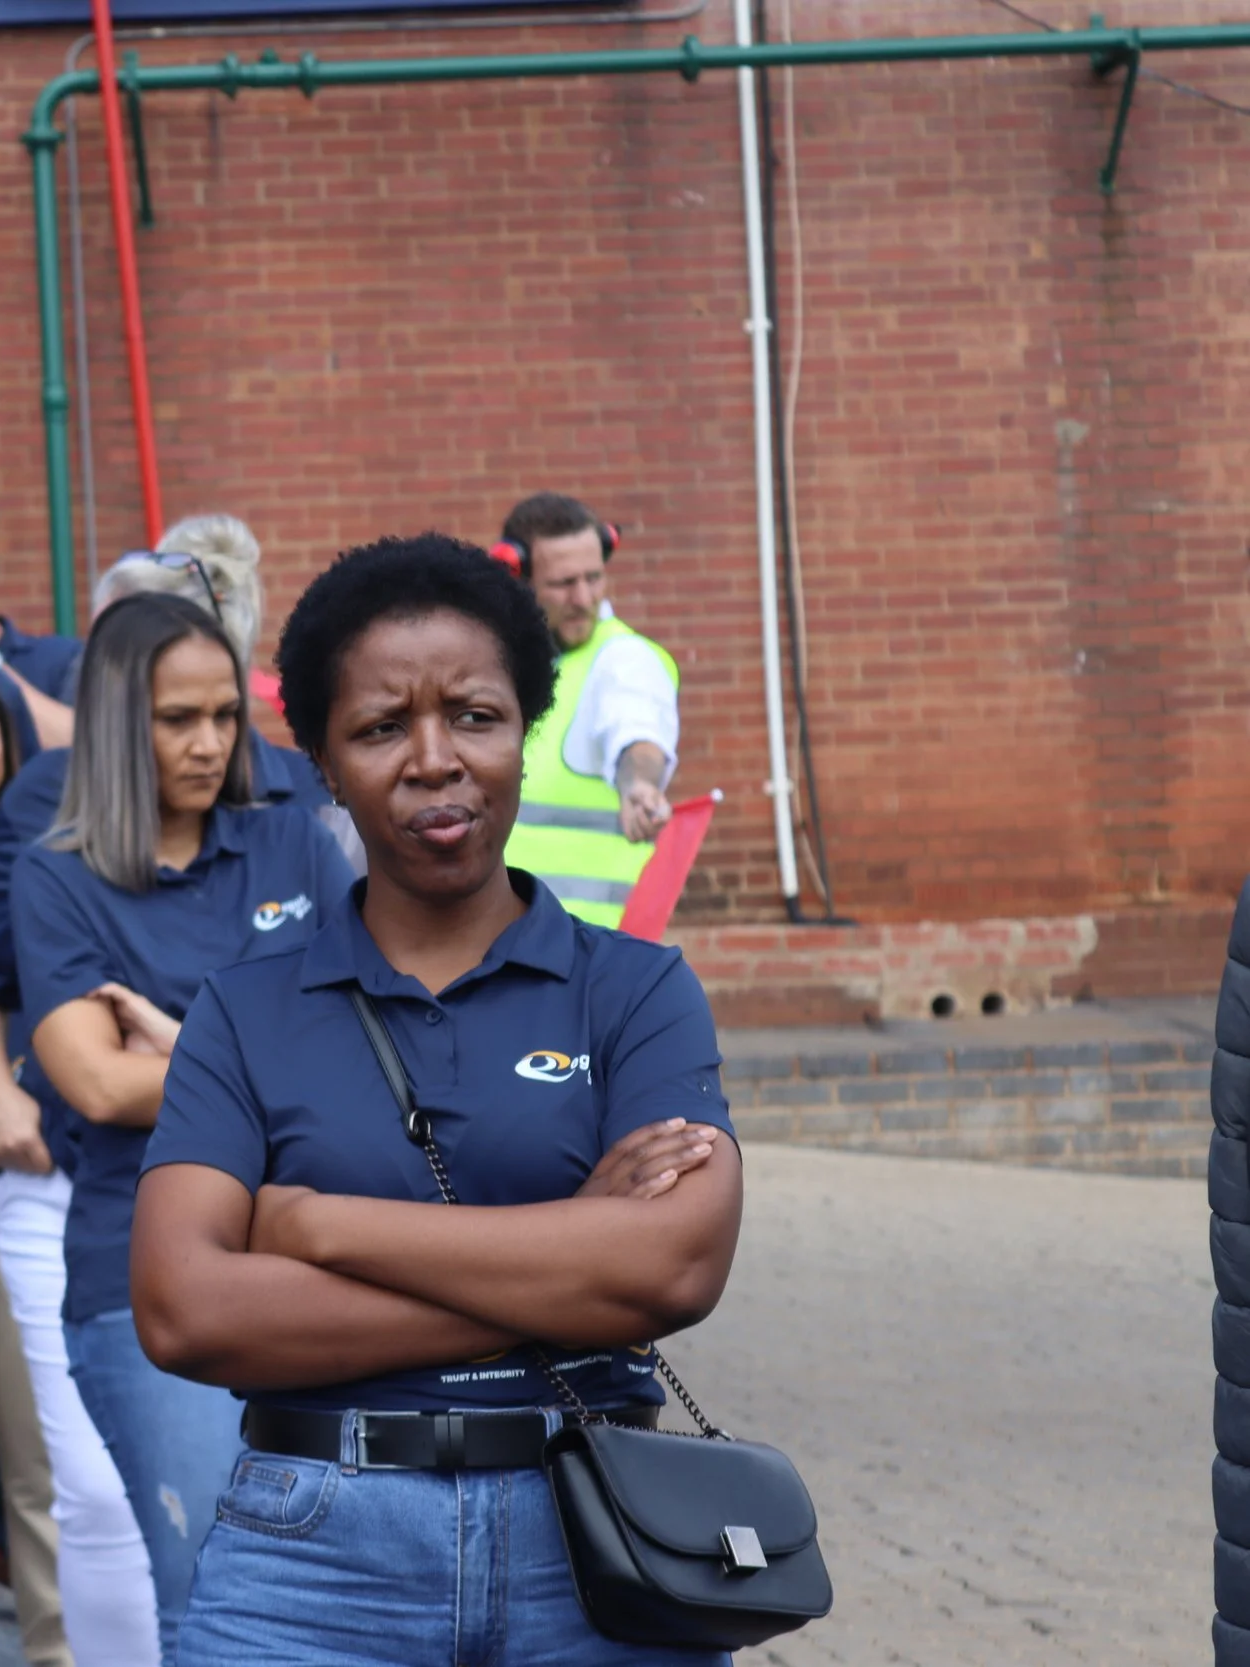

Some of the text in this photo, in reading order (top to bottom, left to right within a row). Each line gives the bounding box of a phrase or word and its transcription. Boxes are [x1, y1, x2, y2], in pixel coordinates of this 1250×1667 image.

[440, 1368, 526, 1384] TRUST & INTEGRITY
